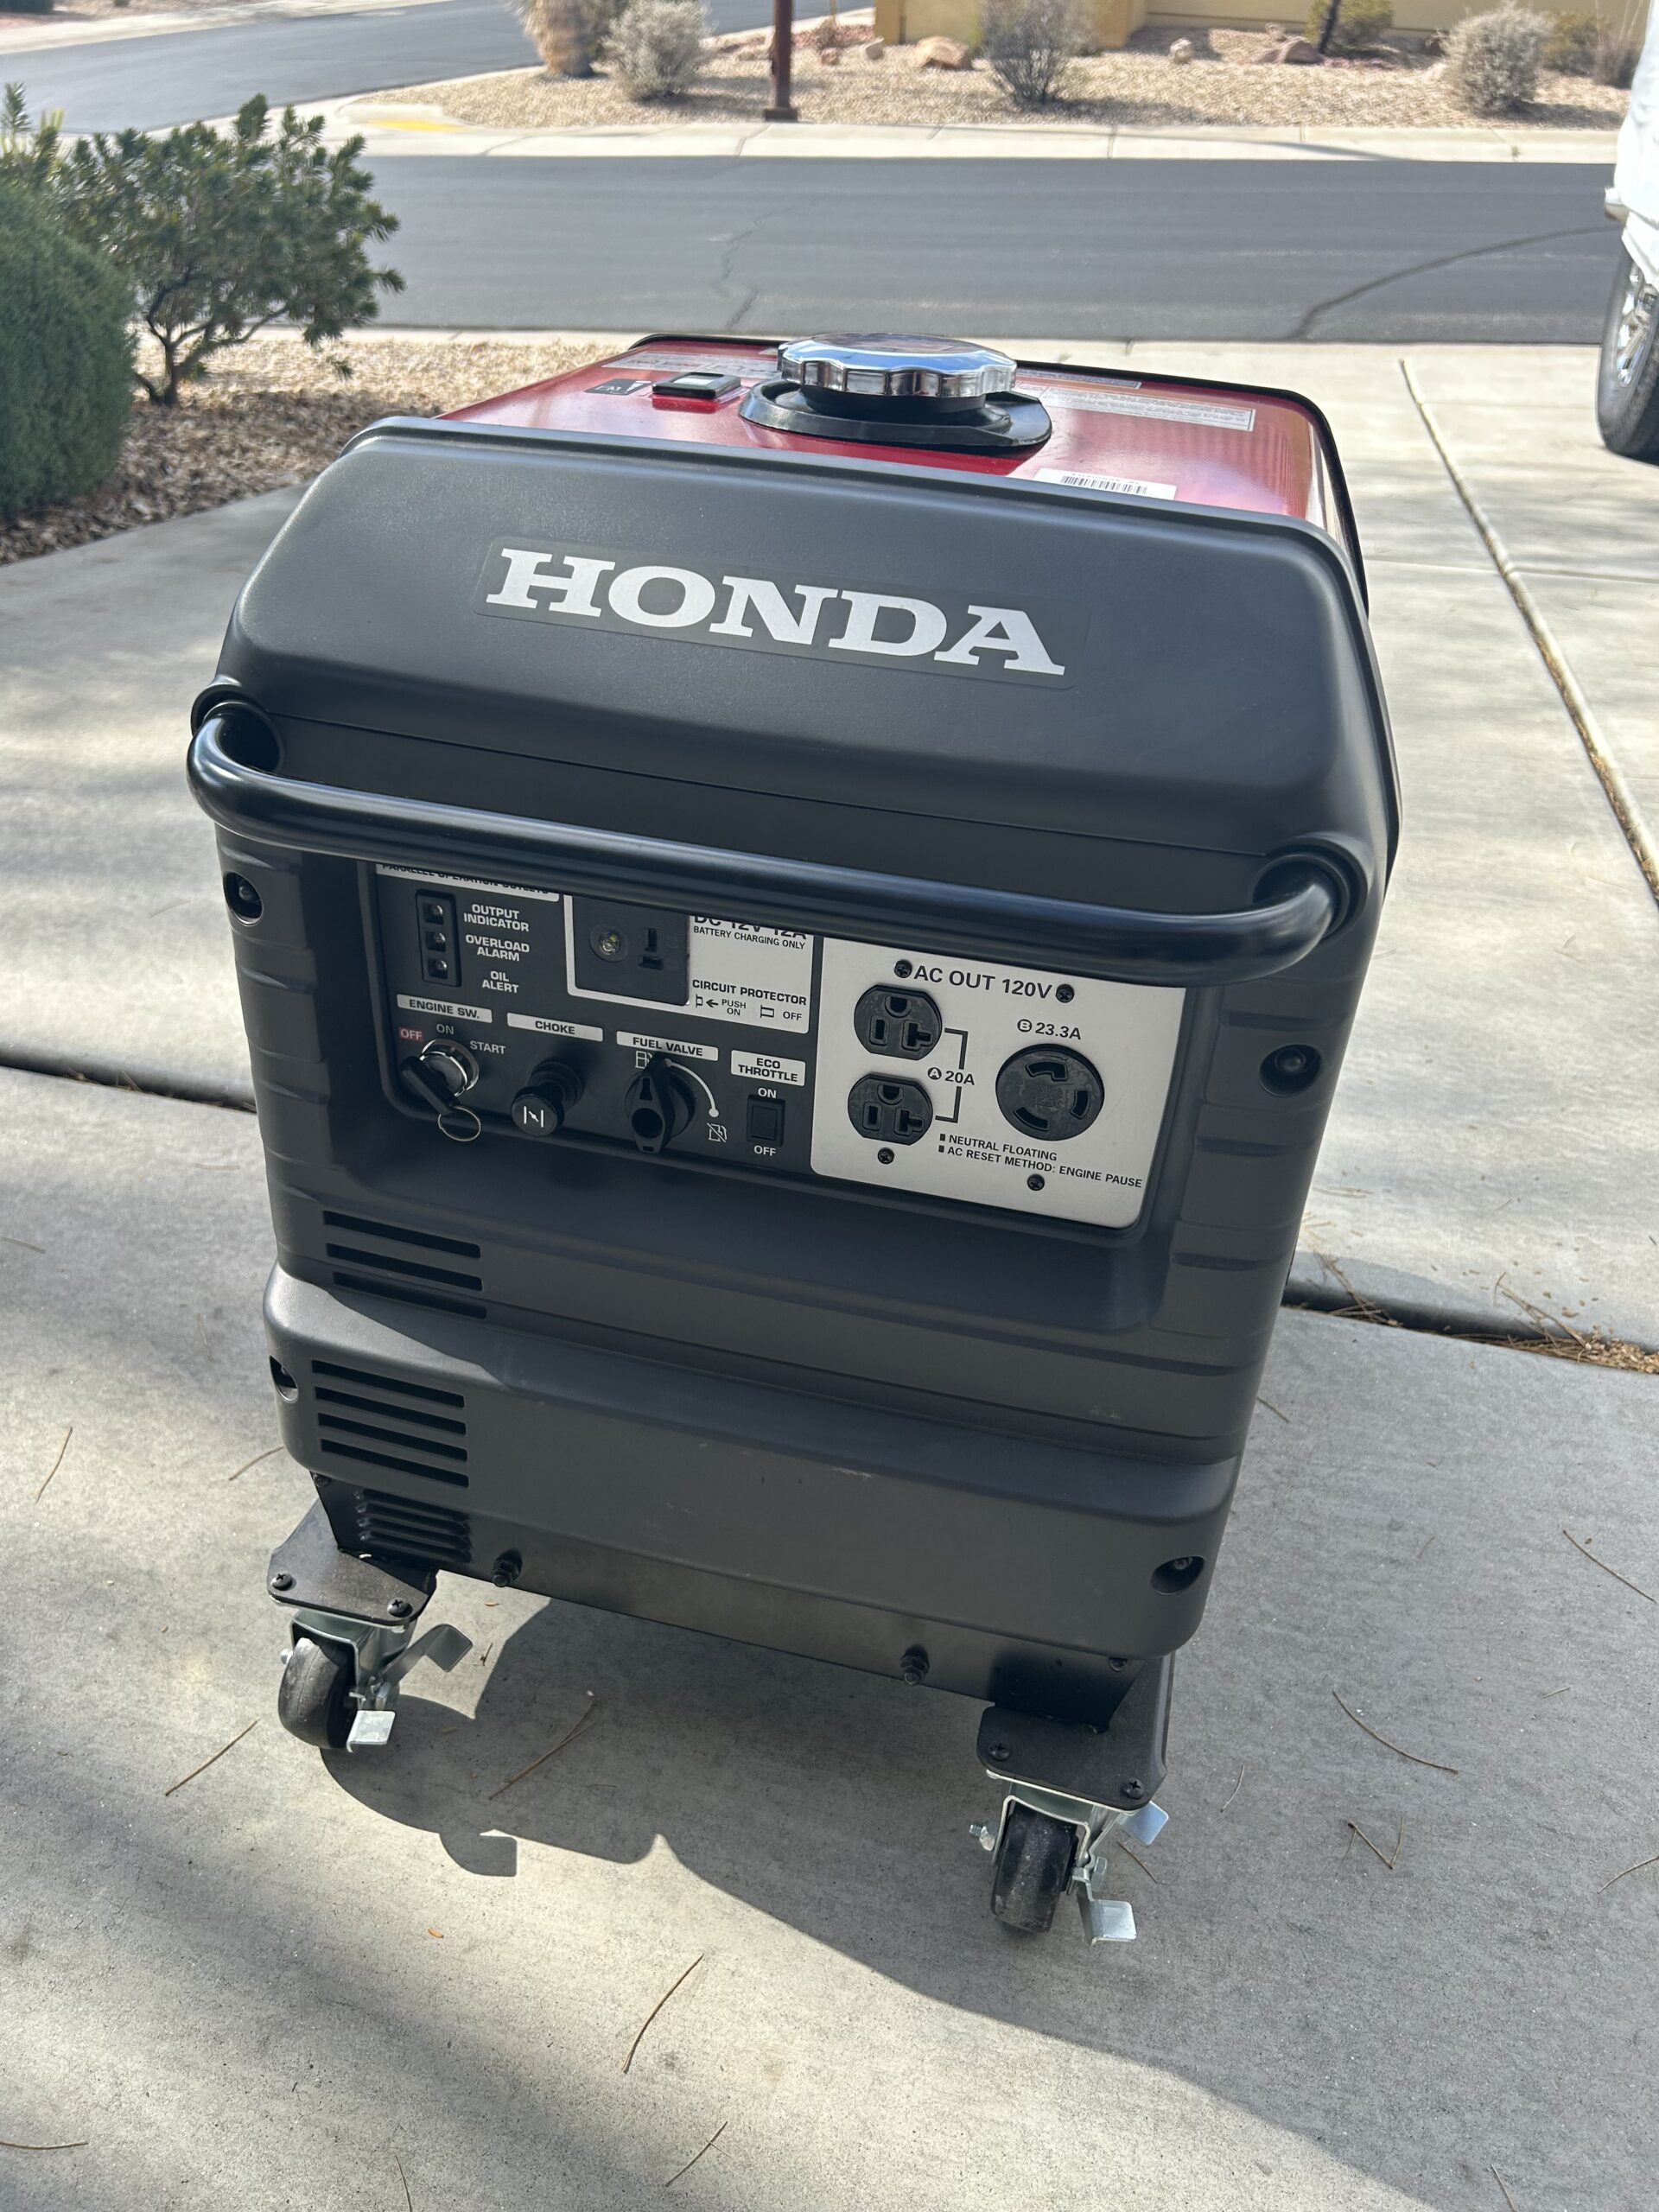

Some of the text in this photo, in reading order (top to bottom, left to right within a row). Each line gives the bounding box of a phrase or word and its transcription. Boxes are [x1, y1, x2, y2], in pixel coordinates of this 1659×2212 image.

[486, 548, 1065, 675] HONDA
[472, 904, 519, 919] OUTPUT
[464, 912, 529, 931] INDICATOR
[466, 934, 530, 952] OVERLOAD
[694, 925, 805, 950] BATTERY CHARGING ONLY
[477, 946, 519, 961] ALARM
[491, 970, 510, 982] OIL
[913, 965, 1052, 999] AC OUT 120V
[482, 979, 519, 993] ALERT
[692, 979, 806, 1006] CIRCUIT PROTECTOR
[409, 999, 480, 1019] ENGINE SW.
[721, 999, 747, 1009] PUSH
[783, 1011, 802, 1020] OFF
[400, 1028, 423, 1040] OFF
[436, 1023, 454, 1035] ON
[535, 1020, 575, 1034] CHOKE
[1035, 1022, 1081, 1039] 23.3A
[470, 1039, 506, 1054] START
[632, 1037, 703, 1056] FUEL VALVE
[756, 1058, 780, 1069] ECO
[738, 1065, 798, 1082] THROTTLE
[944, 1071, 975, 1085] 20A
[758, 1087, 777, 1098] ON
[753, 1145, 776, 1156] OFF
[949, 1135, 1058, 1161] NEUTRAL FLOATING
[947, 1146, 1143, 1188] AC RESET METHOD: ENGINE PAUSE
